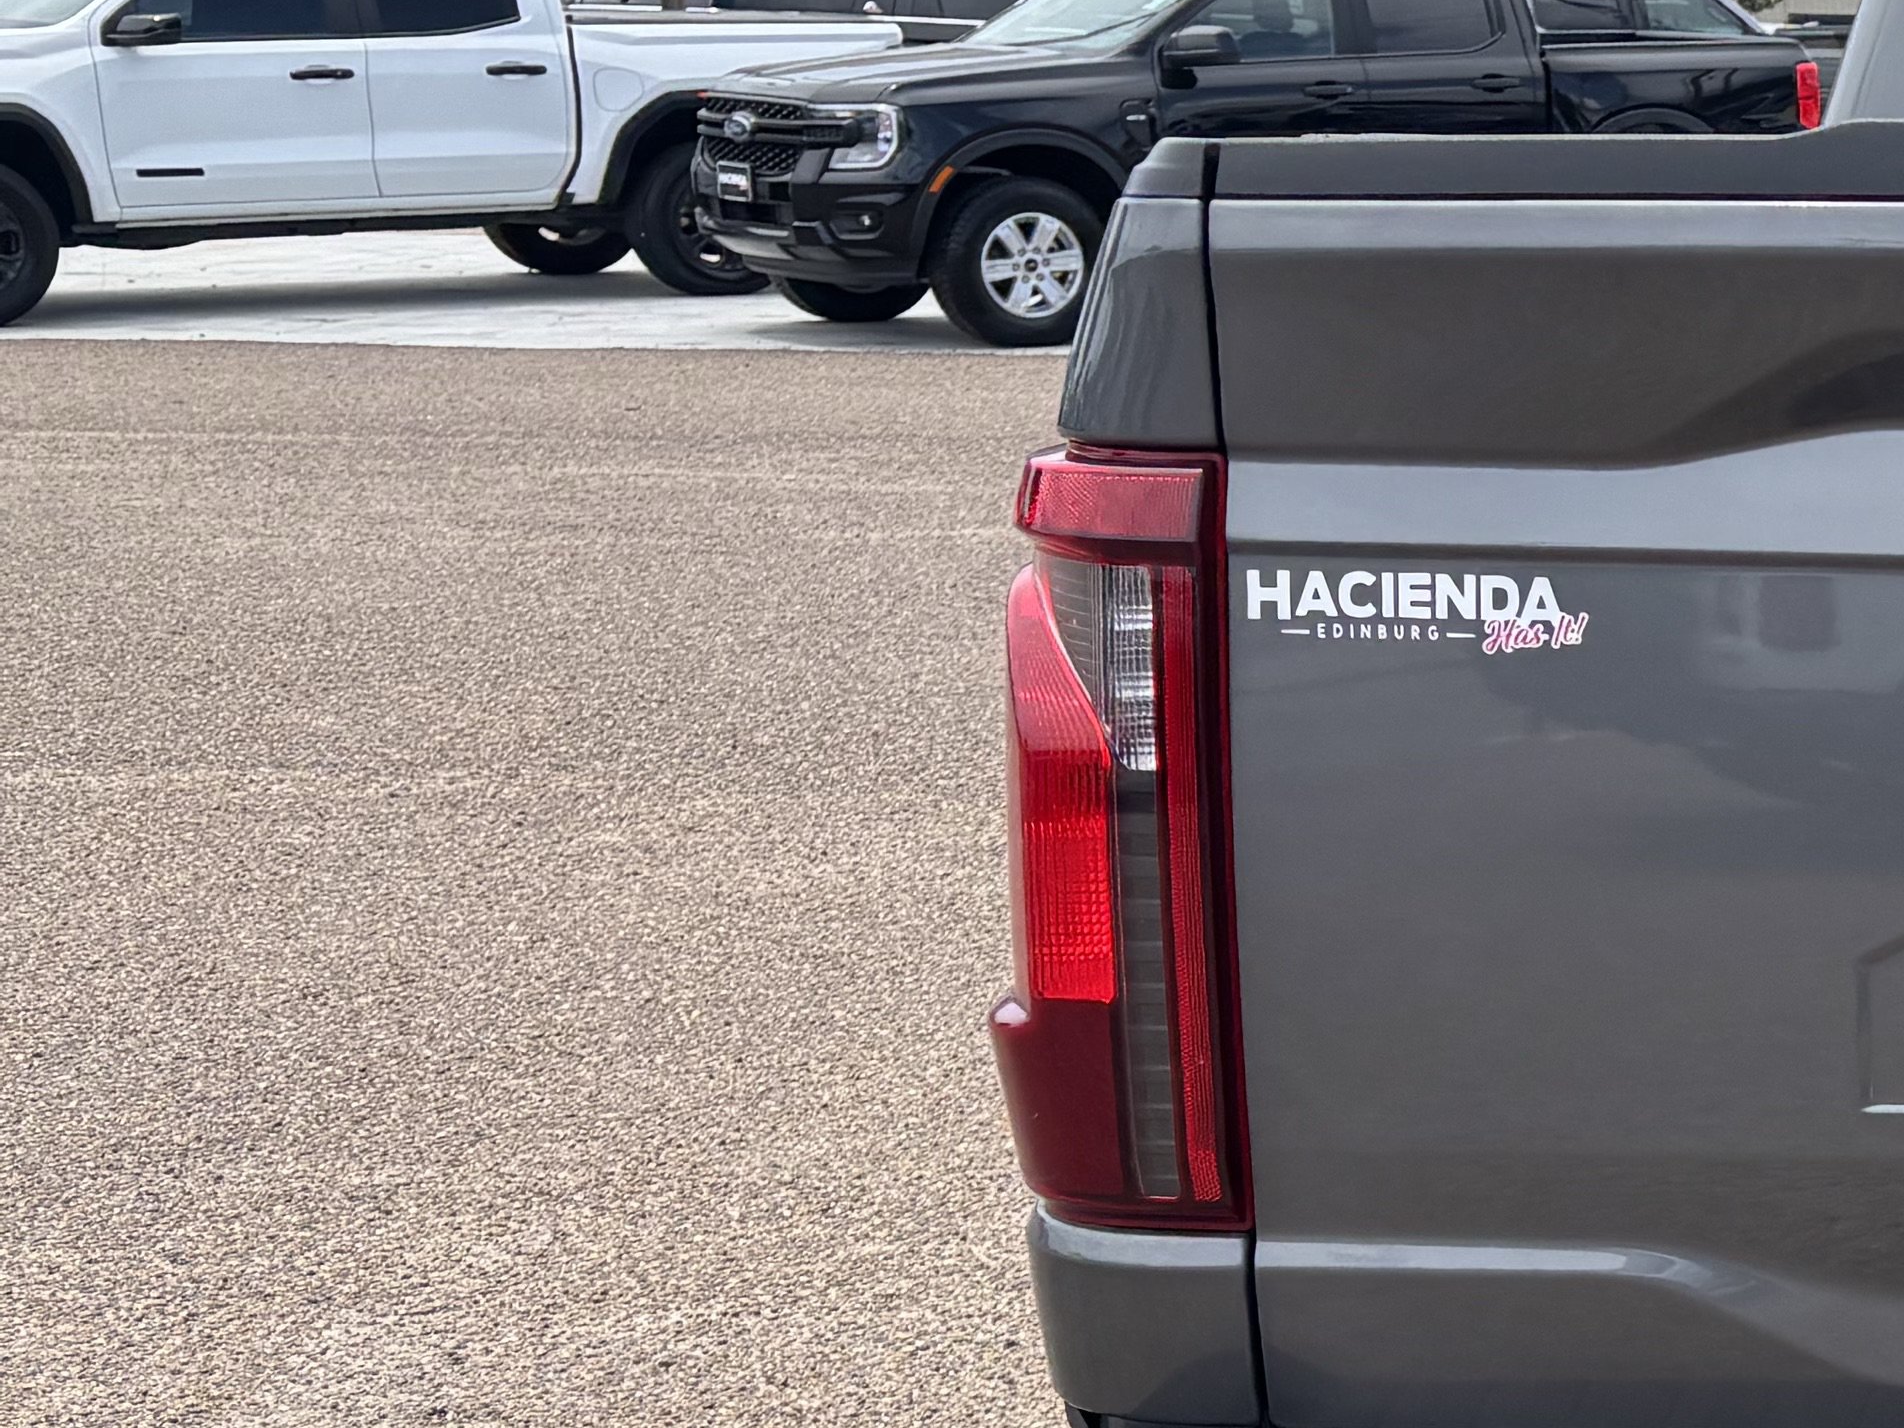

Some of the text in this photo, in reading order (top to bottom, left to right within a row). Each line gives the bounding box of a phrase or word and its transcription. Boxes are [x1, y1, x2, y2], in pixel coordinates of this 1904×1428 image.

[1246, 569, 1563, 624] HACIENDA
[1317, 623, 1440, 641] EDINBURG
[1482, 616, 1550, 655] Has
